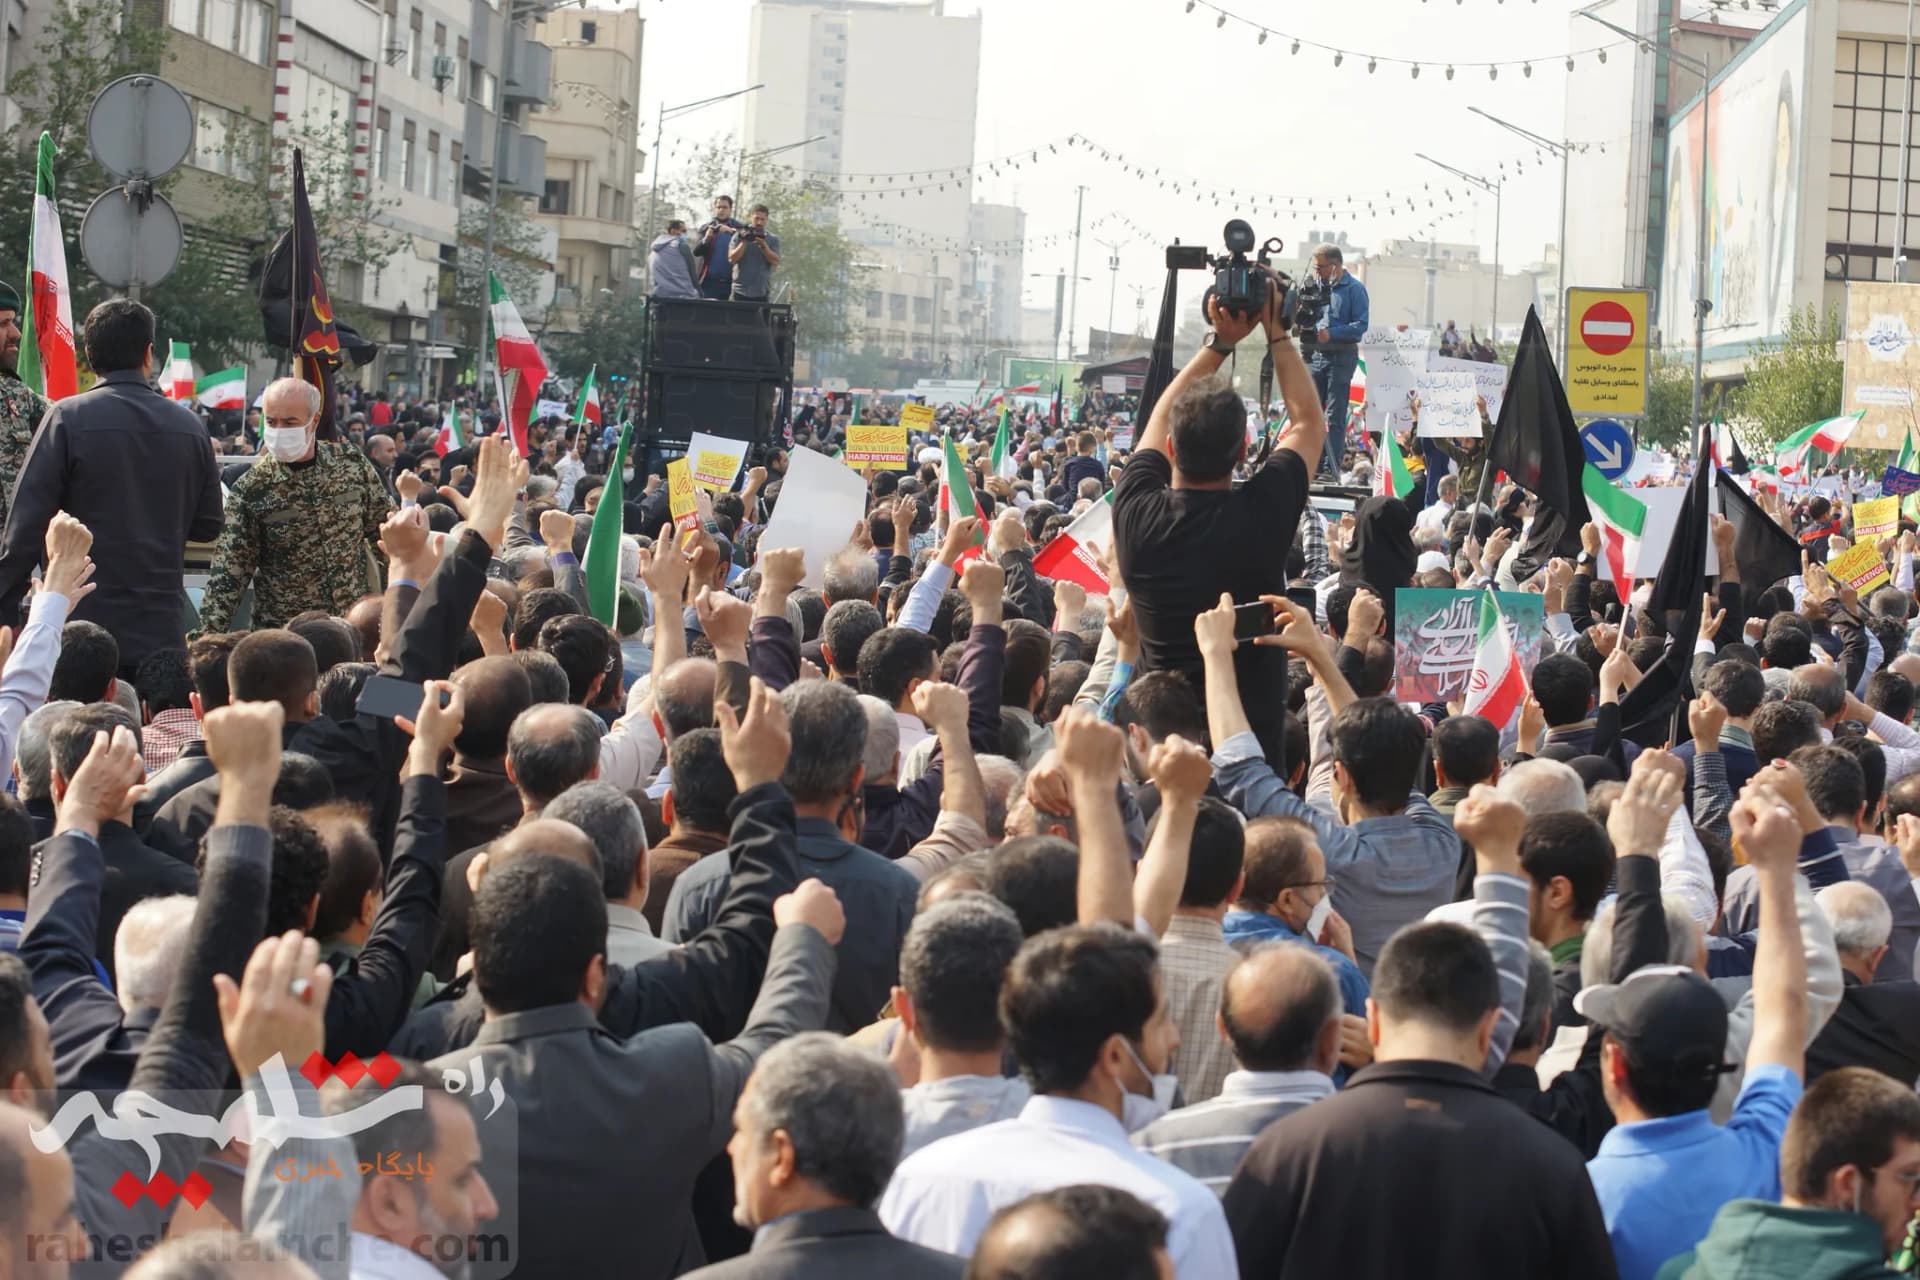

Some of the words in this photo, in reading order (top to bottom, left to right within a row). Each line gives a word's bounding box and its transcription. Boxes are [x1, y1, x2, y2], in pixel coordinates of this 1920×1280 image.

[1576, 362, 1601, 373] اتوبوس
[1603, 364, 1617, 373] ویژه
[1618, 365, 1637, 373] مسیر
[1573, 377, 1589, 386] نقلیه
[1590, 378, 1611, 387] وسایل
[1593, 393, 1618, 401] امدادی
[871, 454, 905, 462] REVENGE
[1853, 562, 1886, 588] REVENGE
